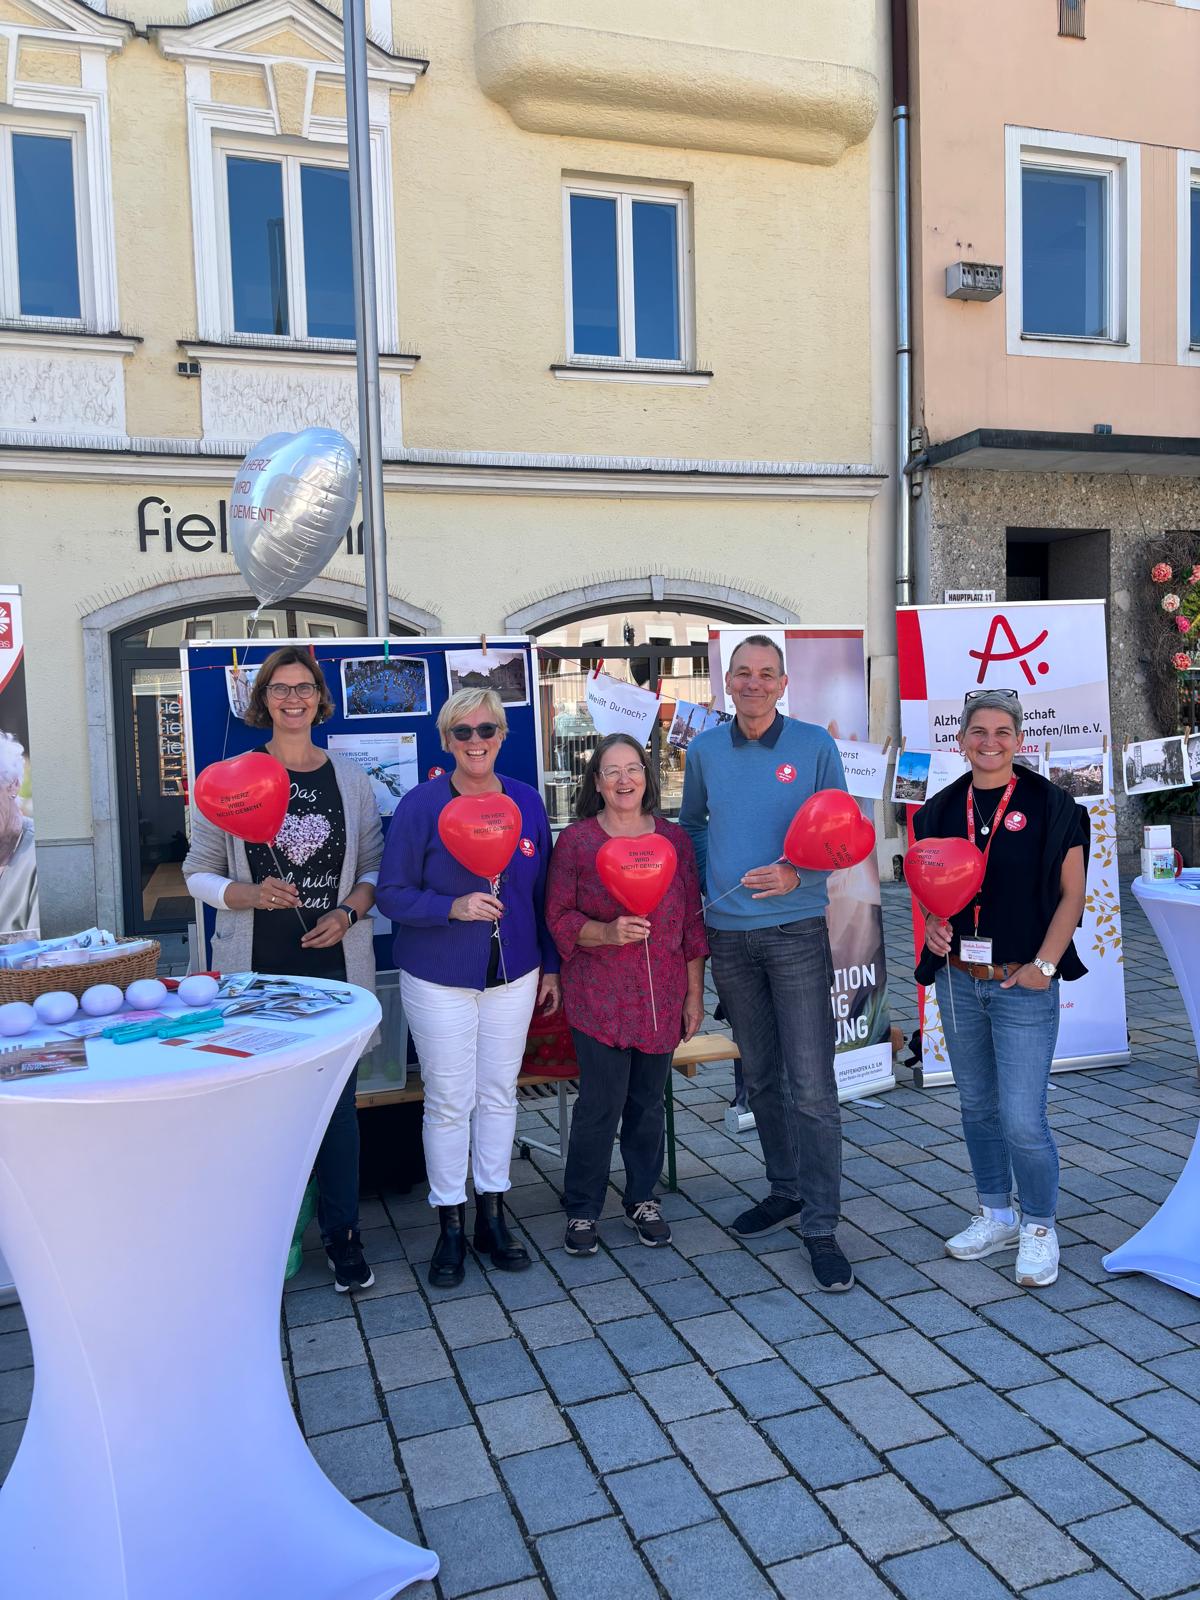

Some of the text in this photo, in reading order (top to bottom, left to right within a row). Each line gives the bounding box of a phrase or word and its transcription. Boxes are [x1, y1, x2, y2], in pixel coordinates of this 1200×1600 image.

[233, 504, 276, 522] DEMENT
[588, 691, 648, 721] Weißt Du noch?
[1023, 708, 1056, 721] schaft
[1093, 723, 1103, 733] V.
[851, 767, 877, 776] noch?
[302, 869, 340, 888] nicht
